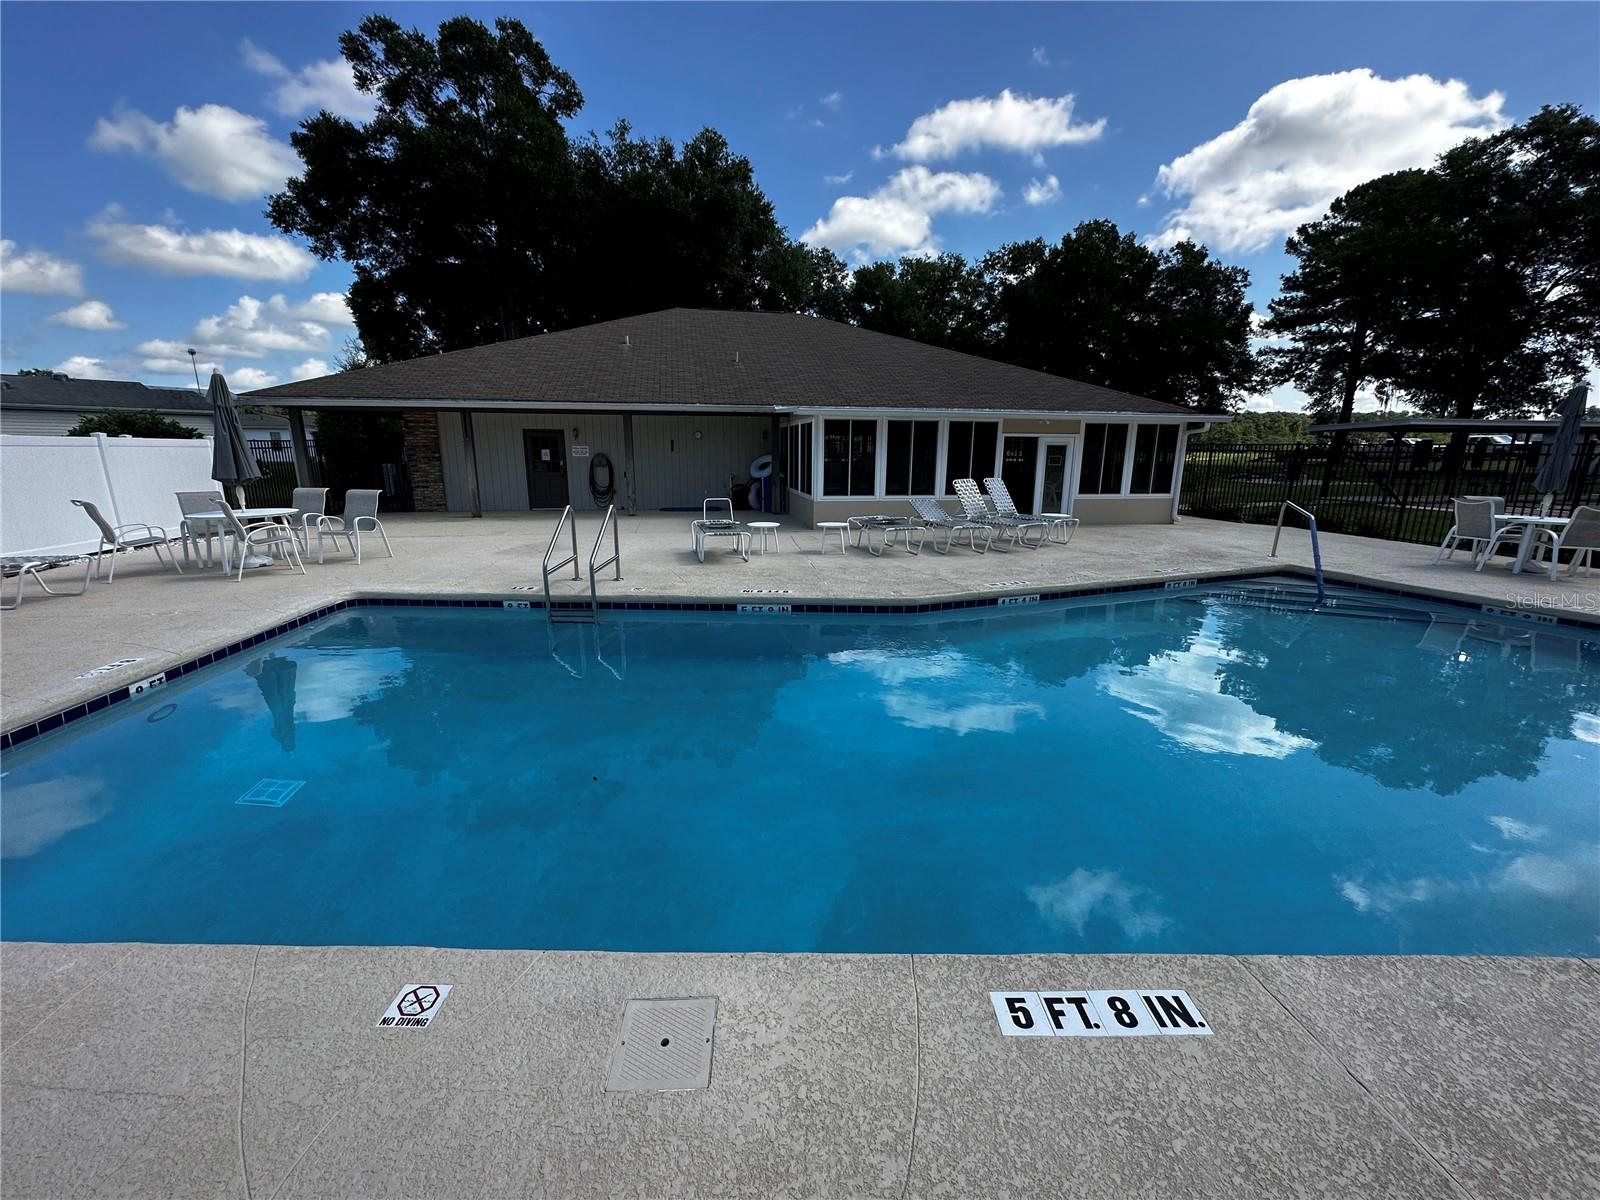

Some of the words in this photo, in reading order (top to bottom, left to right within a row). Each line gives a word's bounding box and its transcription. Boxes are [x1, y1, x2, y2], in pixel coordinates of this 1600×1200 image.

[379, 1016, 396, 1026] NO
[395, 1017, 429, 1027] DIVING
[1005, 997, 1034, 1029] 5
[1043, 997, 1100, 1029] FT.
[1107, 996, 1138, 1028] 8
[1142, 996, 1206, 1028] IN.
